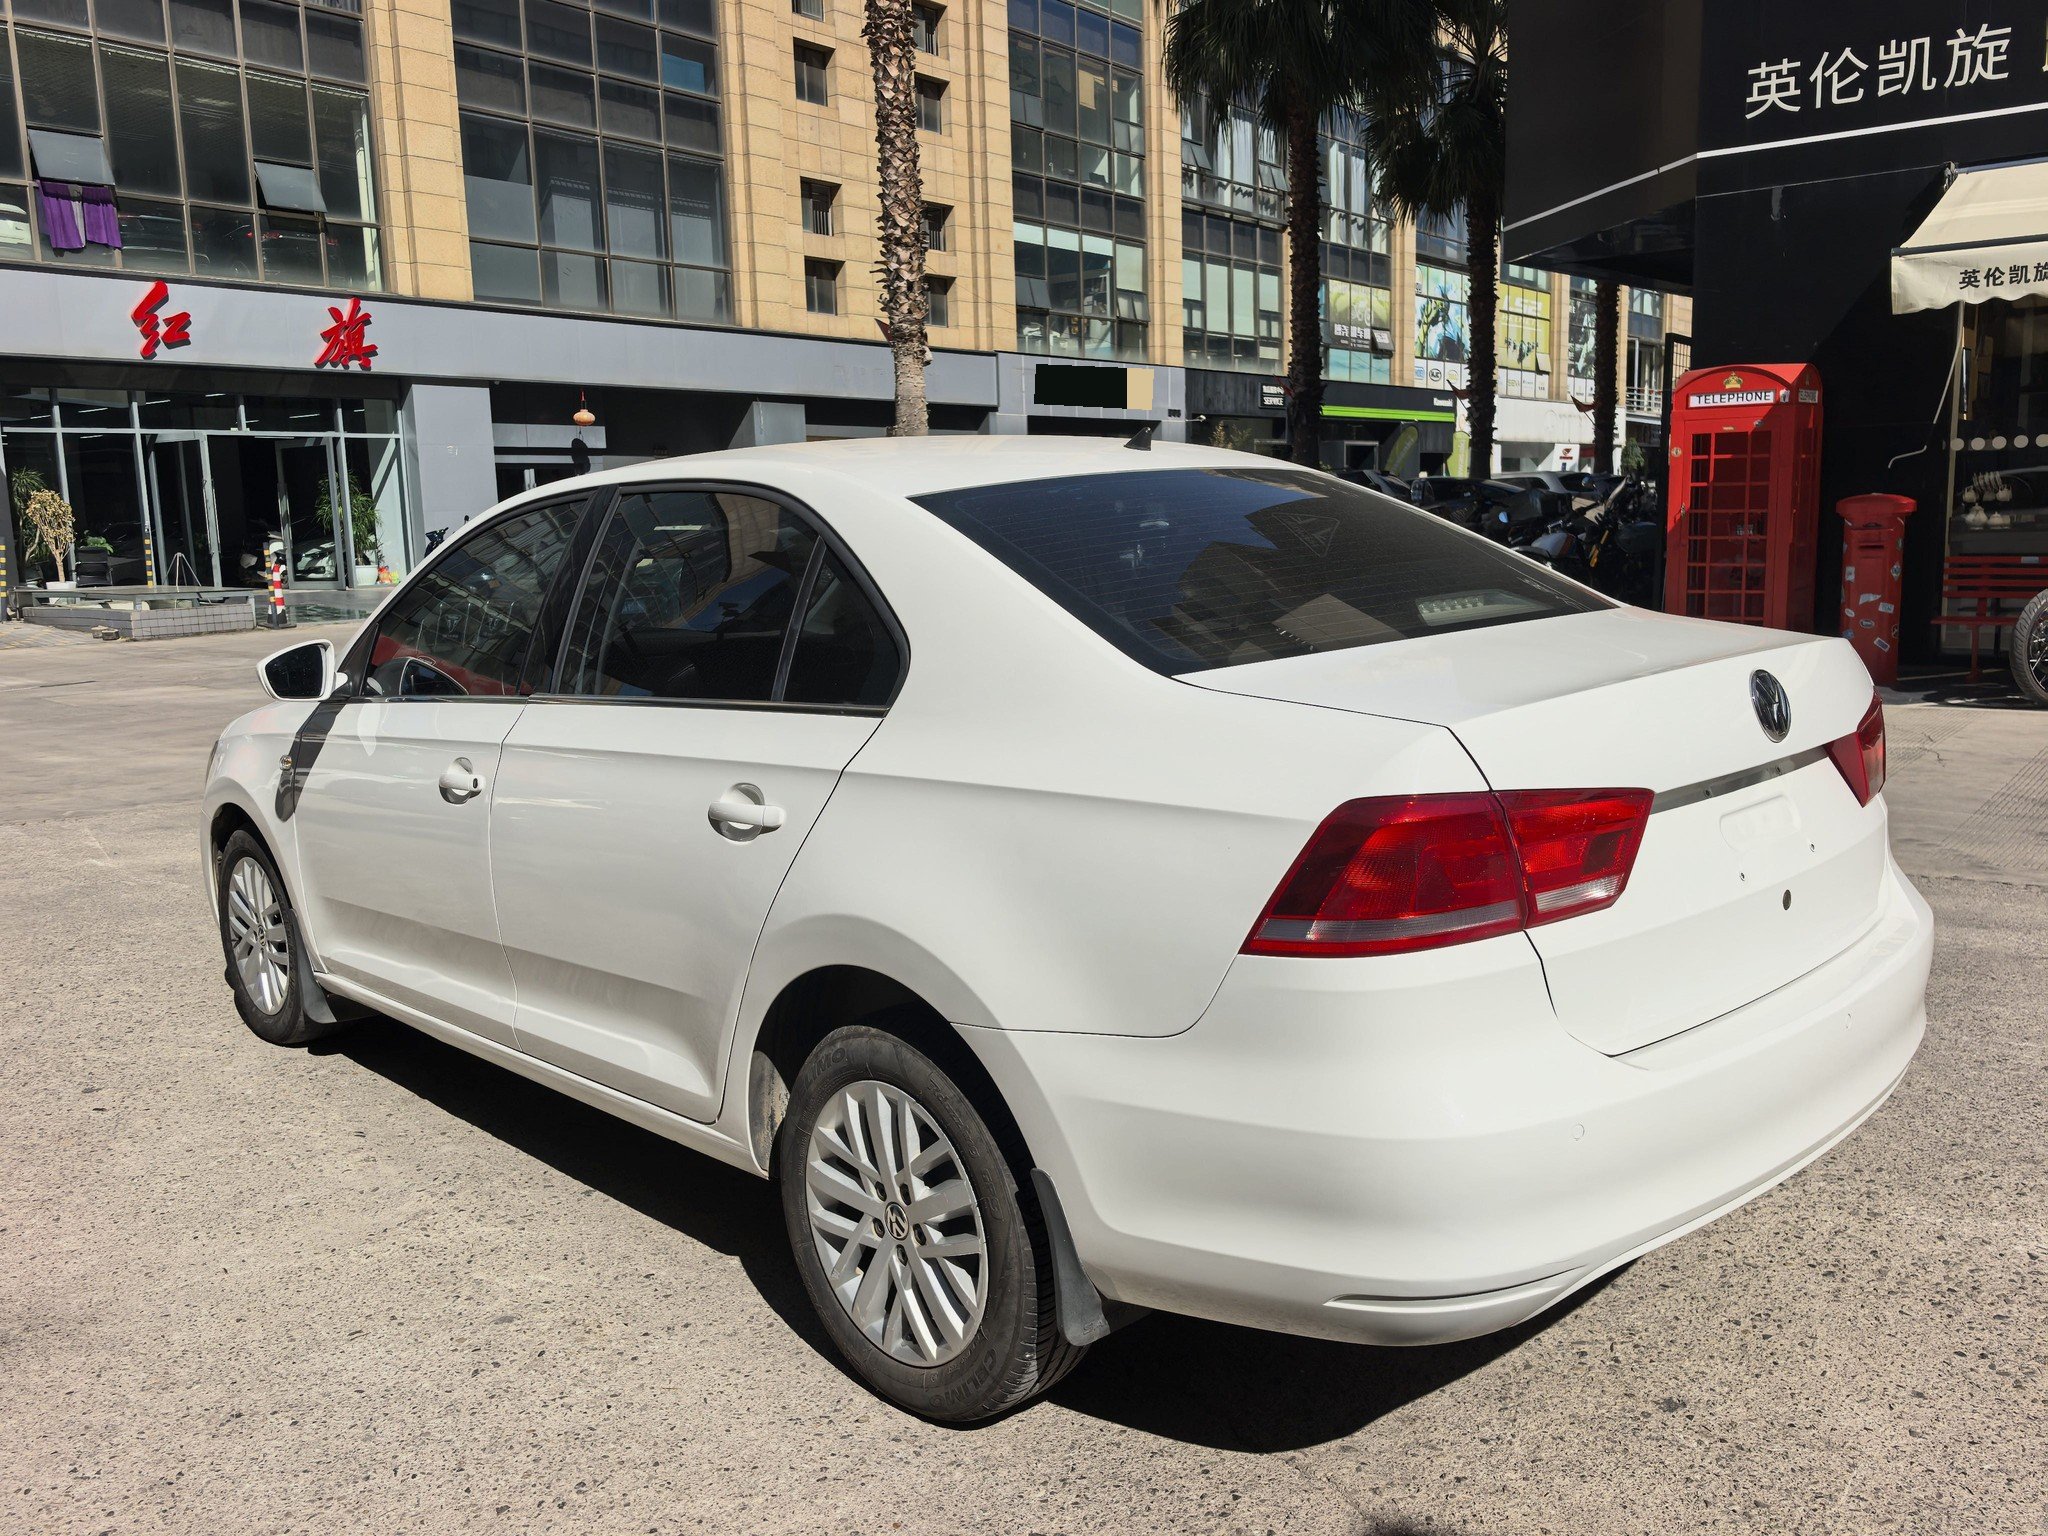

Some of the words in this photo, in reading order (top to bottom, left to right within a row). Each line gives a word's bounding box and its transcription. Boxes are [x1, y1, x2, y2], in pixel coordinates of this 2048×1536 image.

[1745, 23, 2012, 119] 英伦凯旋
[1696, 391, 1772, 405] TELEPHONE
